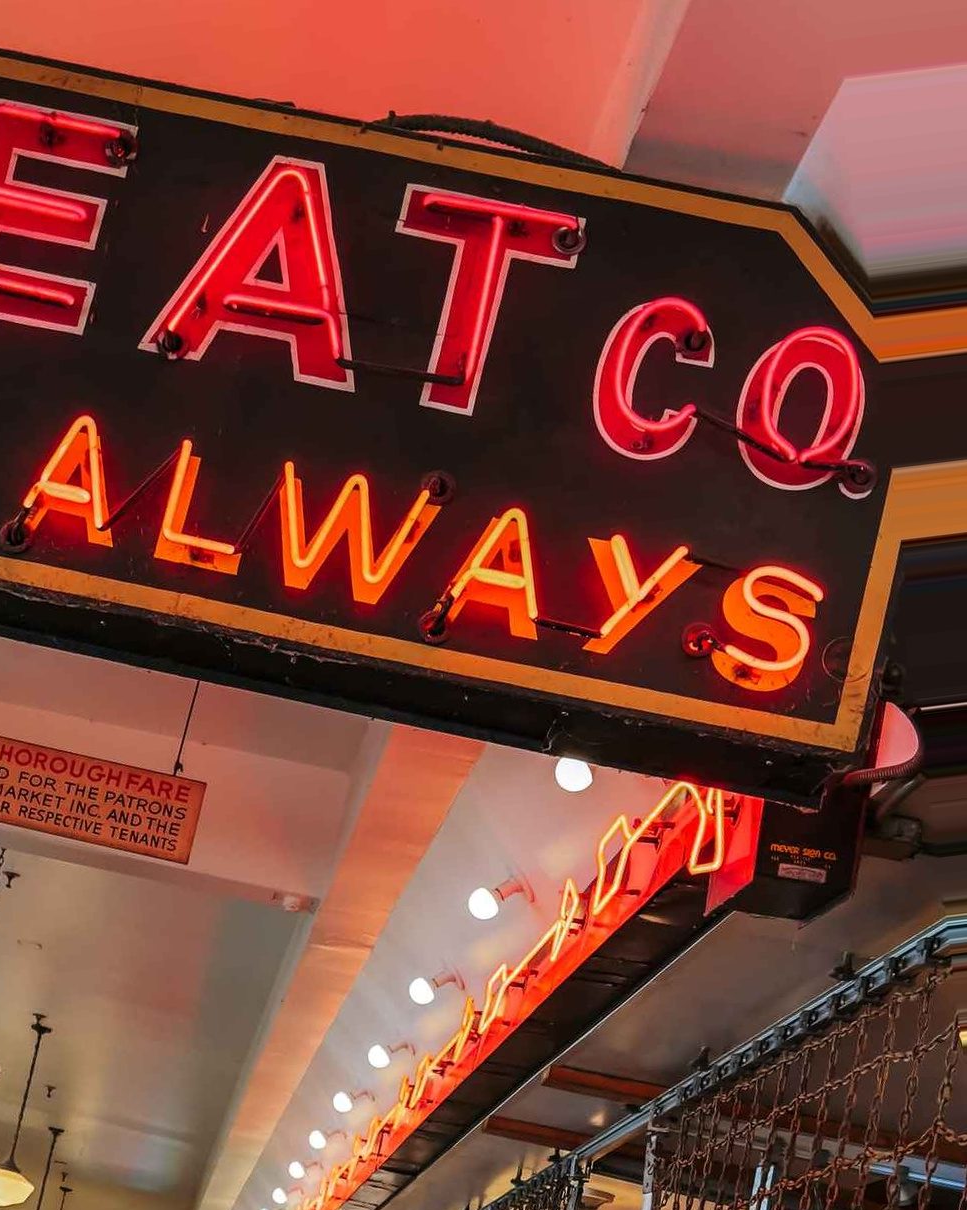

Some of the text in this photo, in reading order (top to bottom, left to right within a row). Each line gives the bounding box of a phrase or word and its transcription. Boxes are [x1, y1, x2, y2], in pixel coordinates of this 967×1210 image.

[593, 296, 867, 495] CO
[18, 415, 825, 692] ALWAYS
[18, 771, 57, 792] FOR
[65, 781, 99, 801] THE
[105, 789, 187, 821] PATRONS
[69, 801, 101, 820] INC.
[106, 809, 142, 828] AND
[146, 817, 181, 837] THE
[18, 804, 102, 836] RESPECTIVE
[110, 825, 177, 852] TENANTS
